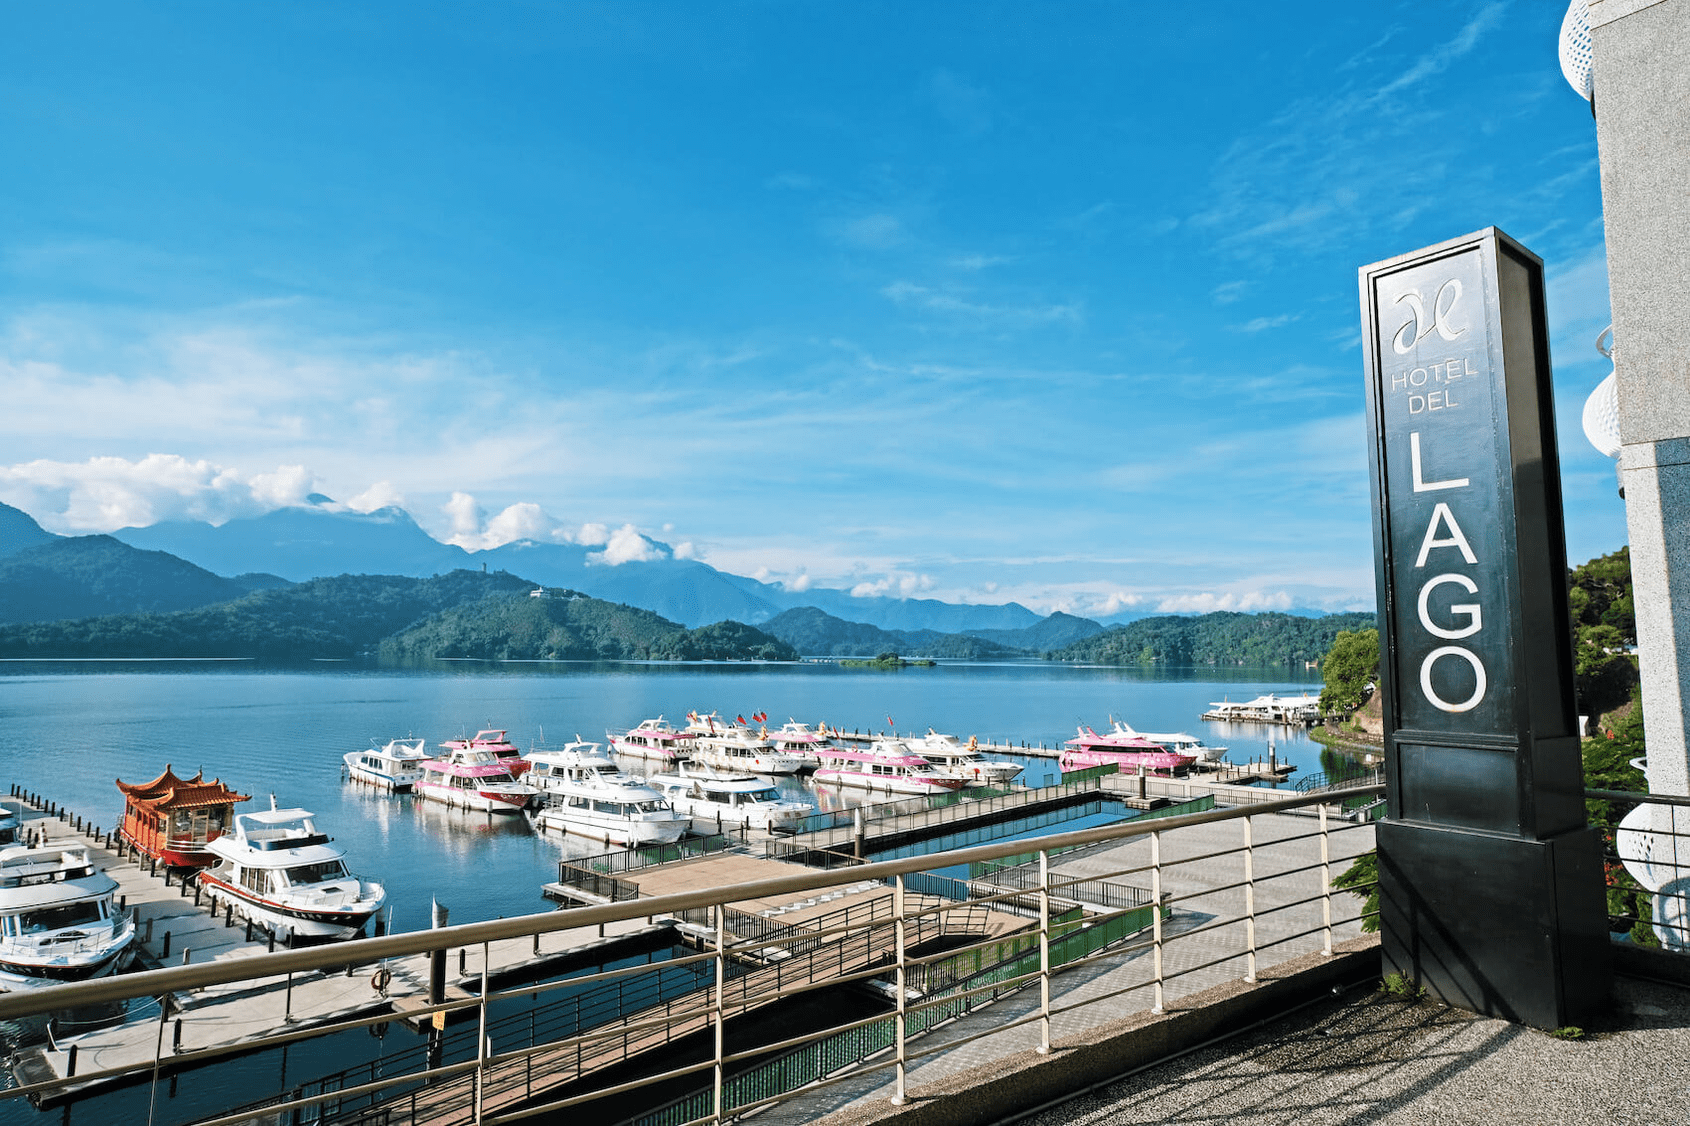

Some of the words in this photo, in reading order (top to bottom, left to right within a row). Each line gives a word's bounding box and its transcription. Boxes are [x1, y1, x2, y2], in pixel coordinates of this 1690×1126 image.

[1390, 358, 1479, 392] HOTEL
[1408, 389, 1459, 415] DEL
[1409, 431, 1487, 713] LAGO
